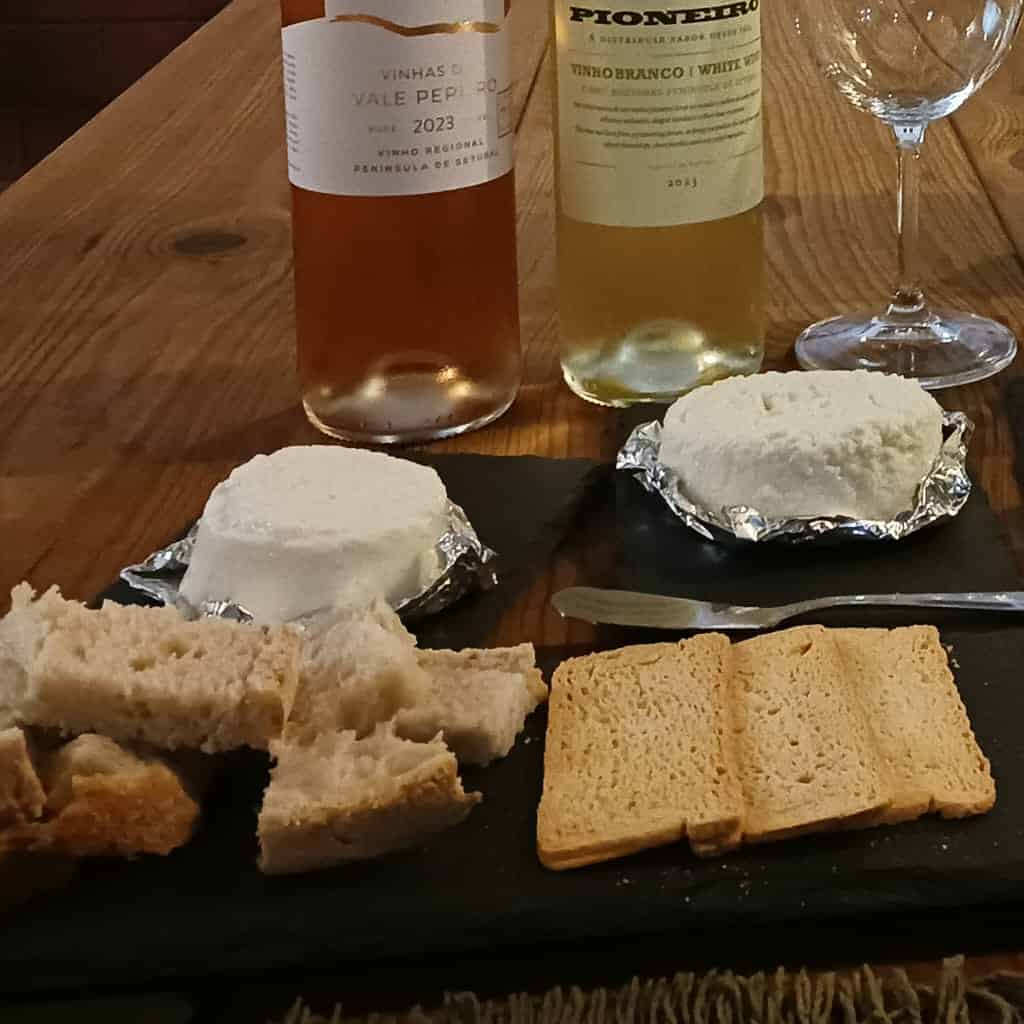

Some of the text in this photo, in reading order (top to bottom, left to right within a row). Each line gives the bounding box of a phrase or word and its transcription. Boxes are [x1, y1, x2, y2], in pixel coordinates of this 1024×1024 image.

[380, 64, 446, 81] VINHAS
[569, 64, 613, 80] VINHO
[615, 66, 685, 81] BRANCO
[697, 58, 741, 77] WHITE
[412, 115, 455, 135] 2023
